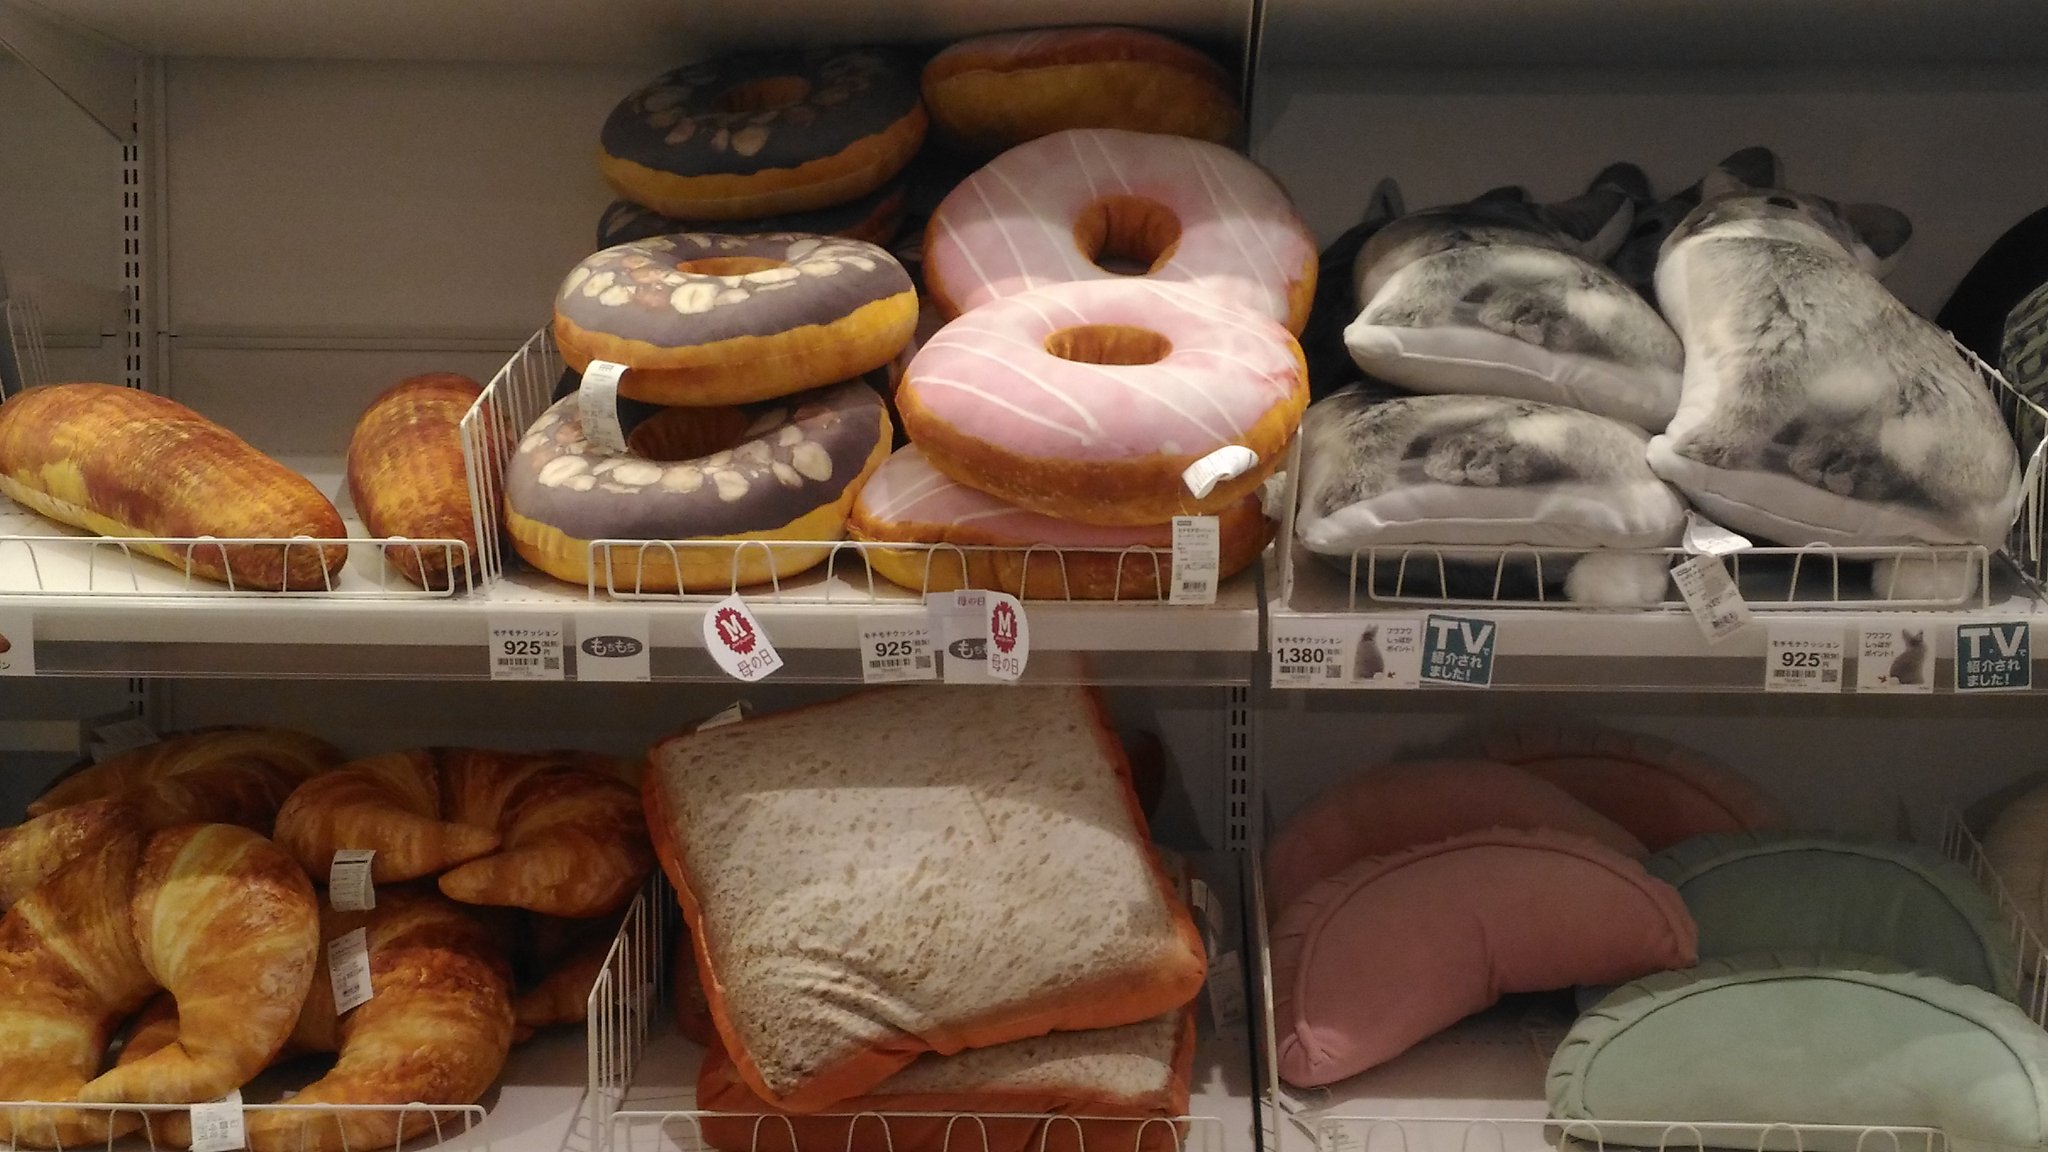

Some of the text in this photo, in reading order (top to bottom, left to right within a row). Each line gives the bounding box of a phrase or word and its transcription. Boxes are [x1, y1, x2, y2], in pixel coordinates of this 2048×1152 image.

[958, 595, 986, 607] 母の日
[720, 614, 748, 642] M
[998, 610, 1012, 637] M
[504, 640, 542, 655] 925
[590, 637, 636, 656] もちもち
[875, 640, 912, 657] 925
[737, 648, 775, 678] 母の日
[1277, 648, 1324, 663] 1,380
[1431, 650, 1483, 668] 紹介され
[1782, 651, 1820, 667] 925
[992, 653, 1019, 675] 母の日
[1967, 658, 2021, 673] 紹介され
[1429, 665, 1471, 681] ました!
[1967, 673, 2010, 687] ました!
